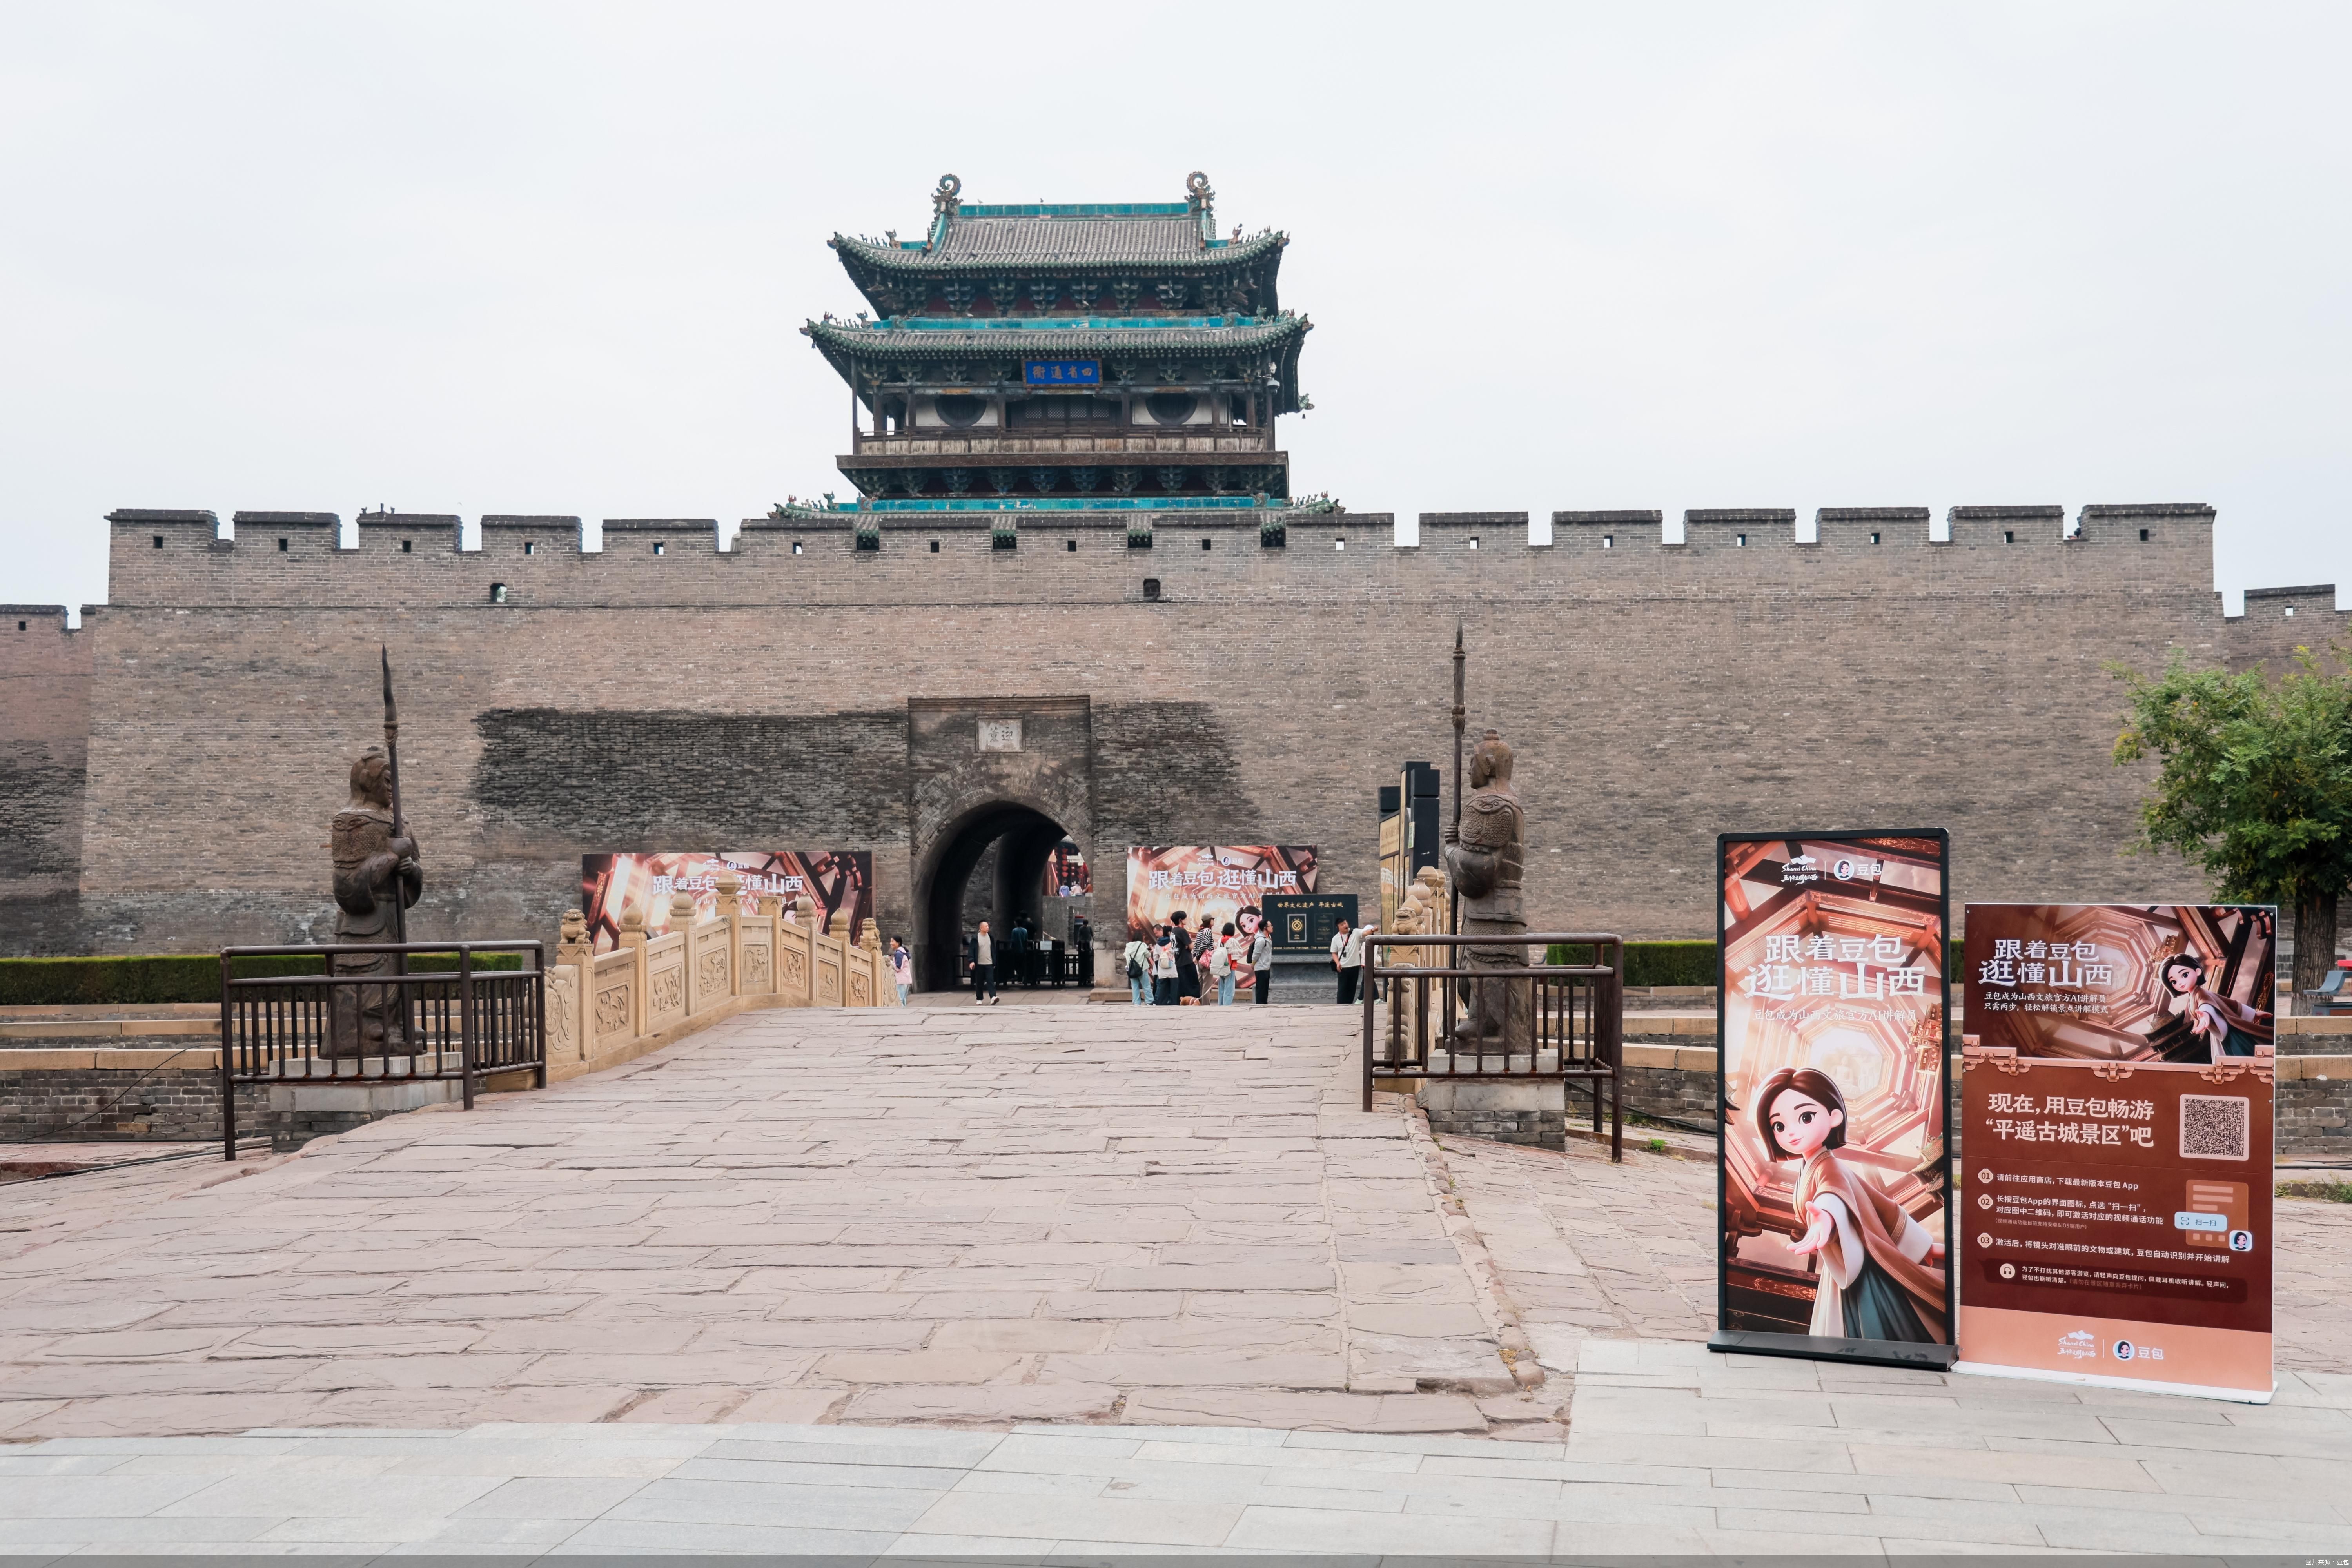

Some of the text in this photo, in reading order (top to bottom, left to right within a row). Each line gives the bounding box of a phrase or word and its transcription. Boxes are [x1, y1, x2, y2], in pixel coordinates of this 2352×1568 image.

[1781, 862, 1800, 873] Shanxi
[1857, 863, 1882, 875] 豆包
[652, 875, 719, 895] 跟着豆包
[1149, 869, 1296, 890] 跟着豆包 逛懂山西
[1764, 934, 1906, 964] 跟着豆包
[1993, 939, 2099, 962] 跟着豆包
[1744, 963, 1926, 1001] 逛懂山西
[1978, 959, 2113, 988] 逛懂山西
[1984, 992, 2106, 1003] 豆包成为山西文旅官方AI讲解员
[1753, 1009, 1916, 1022] 豆包成为山西文旅官方AI讲解员
[1984, 1002, 2109, 1014] 只需两步，轻松解锁景点讲解模式
[1988, 1093, 2154, 1120] 现在，用豆包畅游
[1985, 1118, 2154, 1147] “平遥古城景区”吧
[2122, 1182, 2138, 1191] App
[1996, 1206, 2164, 1225] 对应图中二维码，即可激活对应的视频通话功能
[1996, 1238, 2230, 1263] 激活后，将镜头对准眼前的文物或建筑，豆包自动识别并开始讲解
[2058, 1336, 2078, 1346] Shanxi
[2138, 1347, 2164, 1360] 豆包
